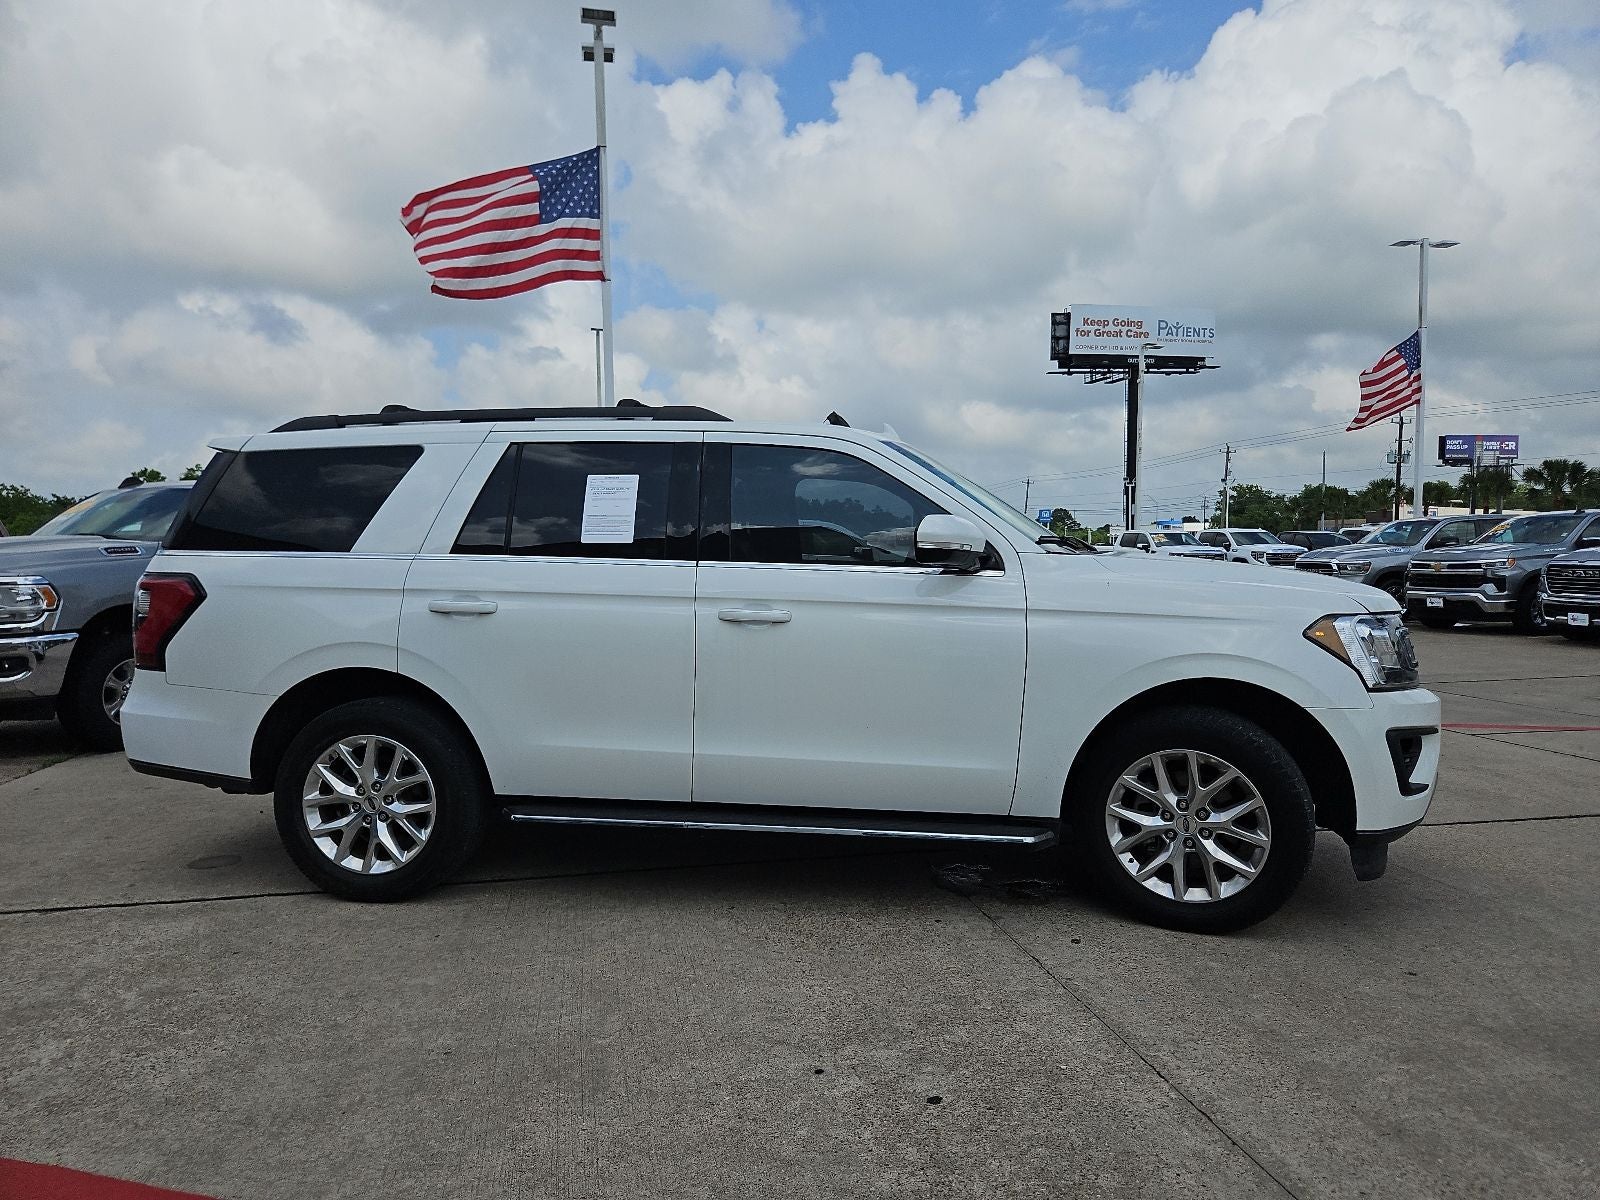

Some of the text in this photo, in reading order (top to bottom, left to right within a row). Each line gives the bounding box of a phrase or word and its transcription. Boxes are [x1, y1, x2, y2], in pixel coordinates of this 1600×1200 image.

[1083, 317, 1143, 329] Keep Going
[1075, 327, 1150, 339] for Great Care
